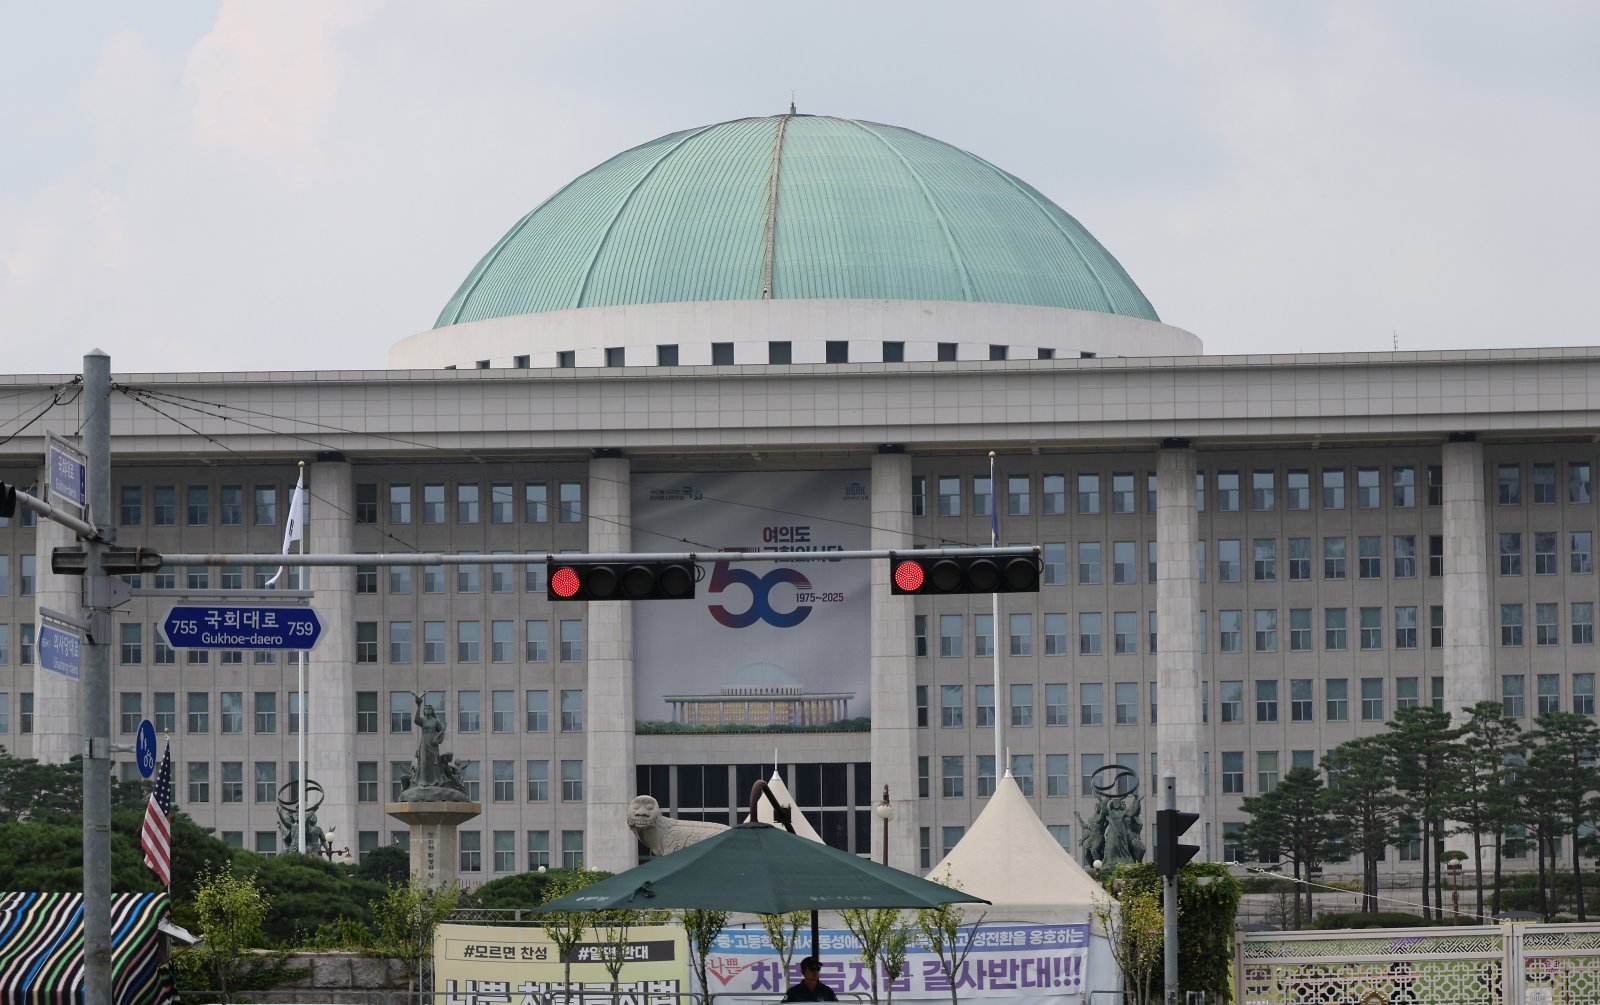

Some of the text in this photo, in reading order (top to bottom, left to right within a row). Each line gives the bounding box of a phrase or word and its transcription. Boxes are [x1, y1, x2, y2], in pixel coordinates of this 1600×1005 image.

[763, 526, 811, 543] 여의도
[796, 592, 844, 603] 1975~2025
[172, 610, 314, 636] 755 국회대로 759
[201, 632, 283, 645] Gukhoe-daero
[973, 930, 1026, 946] 성전환을
[1029, 928, 1084, 945] 옹호하는
[464, 945, 548, 961] #모르면 찬성
[709, 957, 741, 976] 나쁜
[922, 955, 1082, 992] 결사반대!!!
